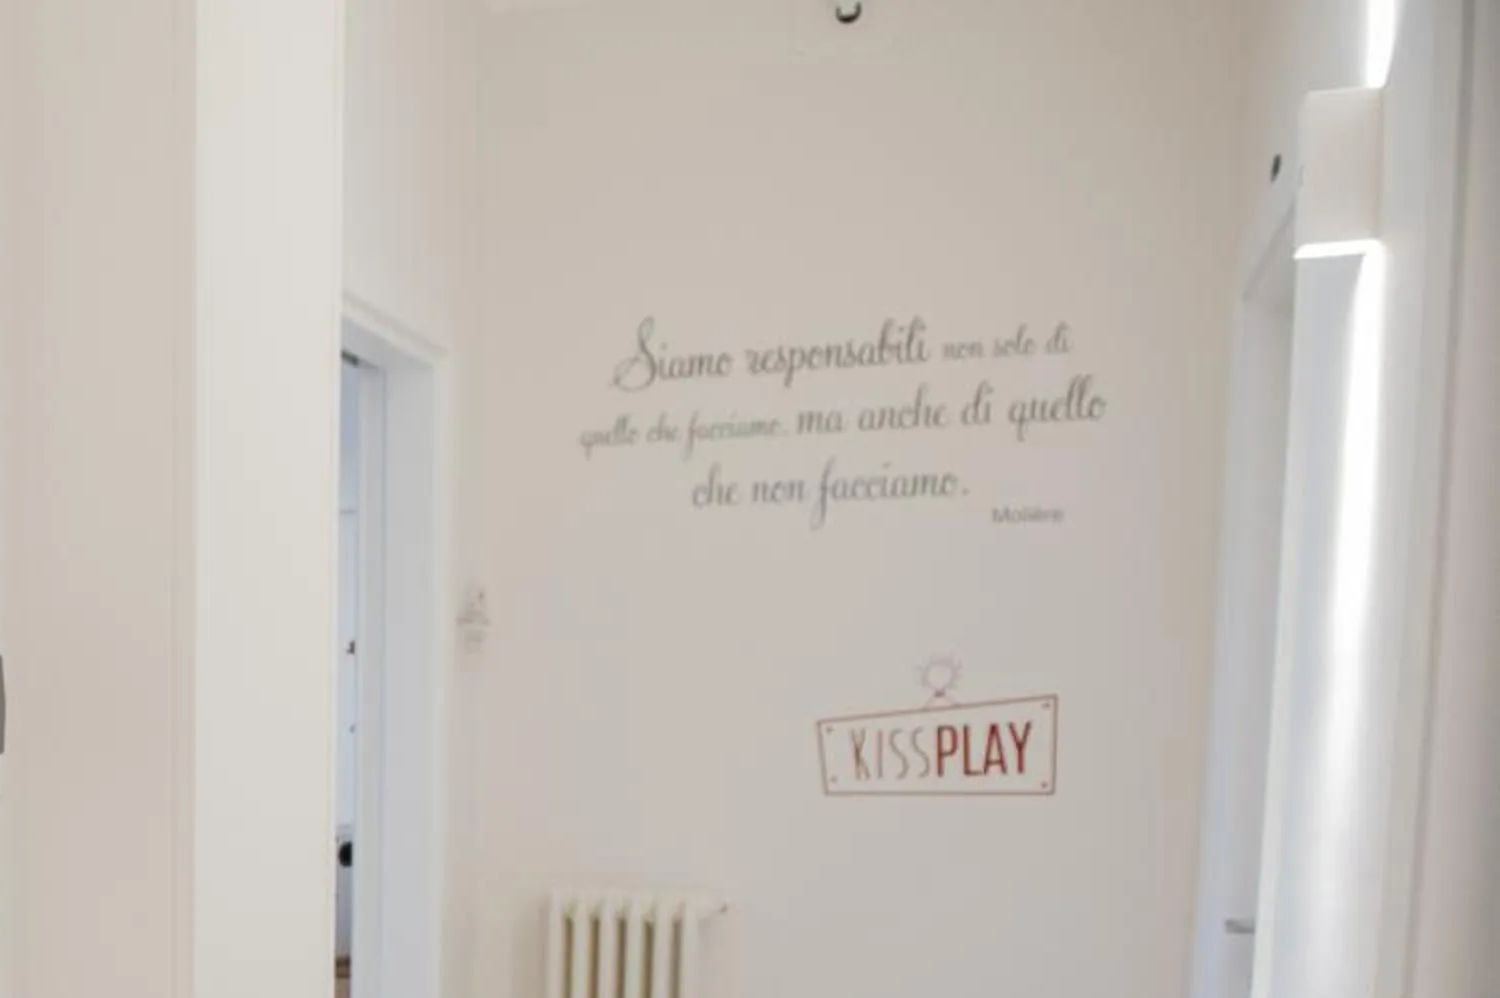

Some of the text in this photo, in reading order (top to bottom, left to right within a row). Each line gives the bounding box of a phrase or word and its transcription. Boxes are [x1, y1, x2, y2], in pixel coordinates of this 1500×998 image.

[608, 315, 1073, 393] Siamo responsabili non solo di
[579, 414, 639, 460] quello
[645, 411, 678, 442] che
[797, 410, 843, 434] ma
[858, 382, 949, 431] anche
[960, 378, 994, 425] di
[1007, 373, 1107, 443] quello
[692, 462, 739, 508] che
[752, 478, 805, 504] non
[850, 721, 1033, 781] KISSPLAY
